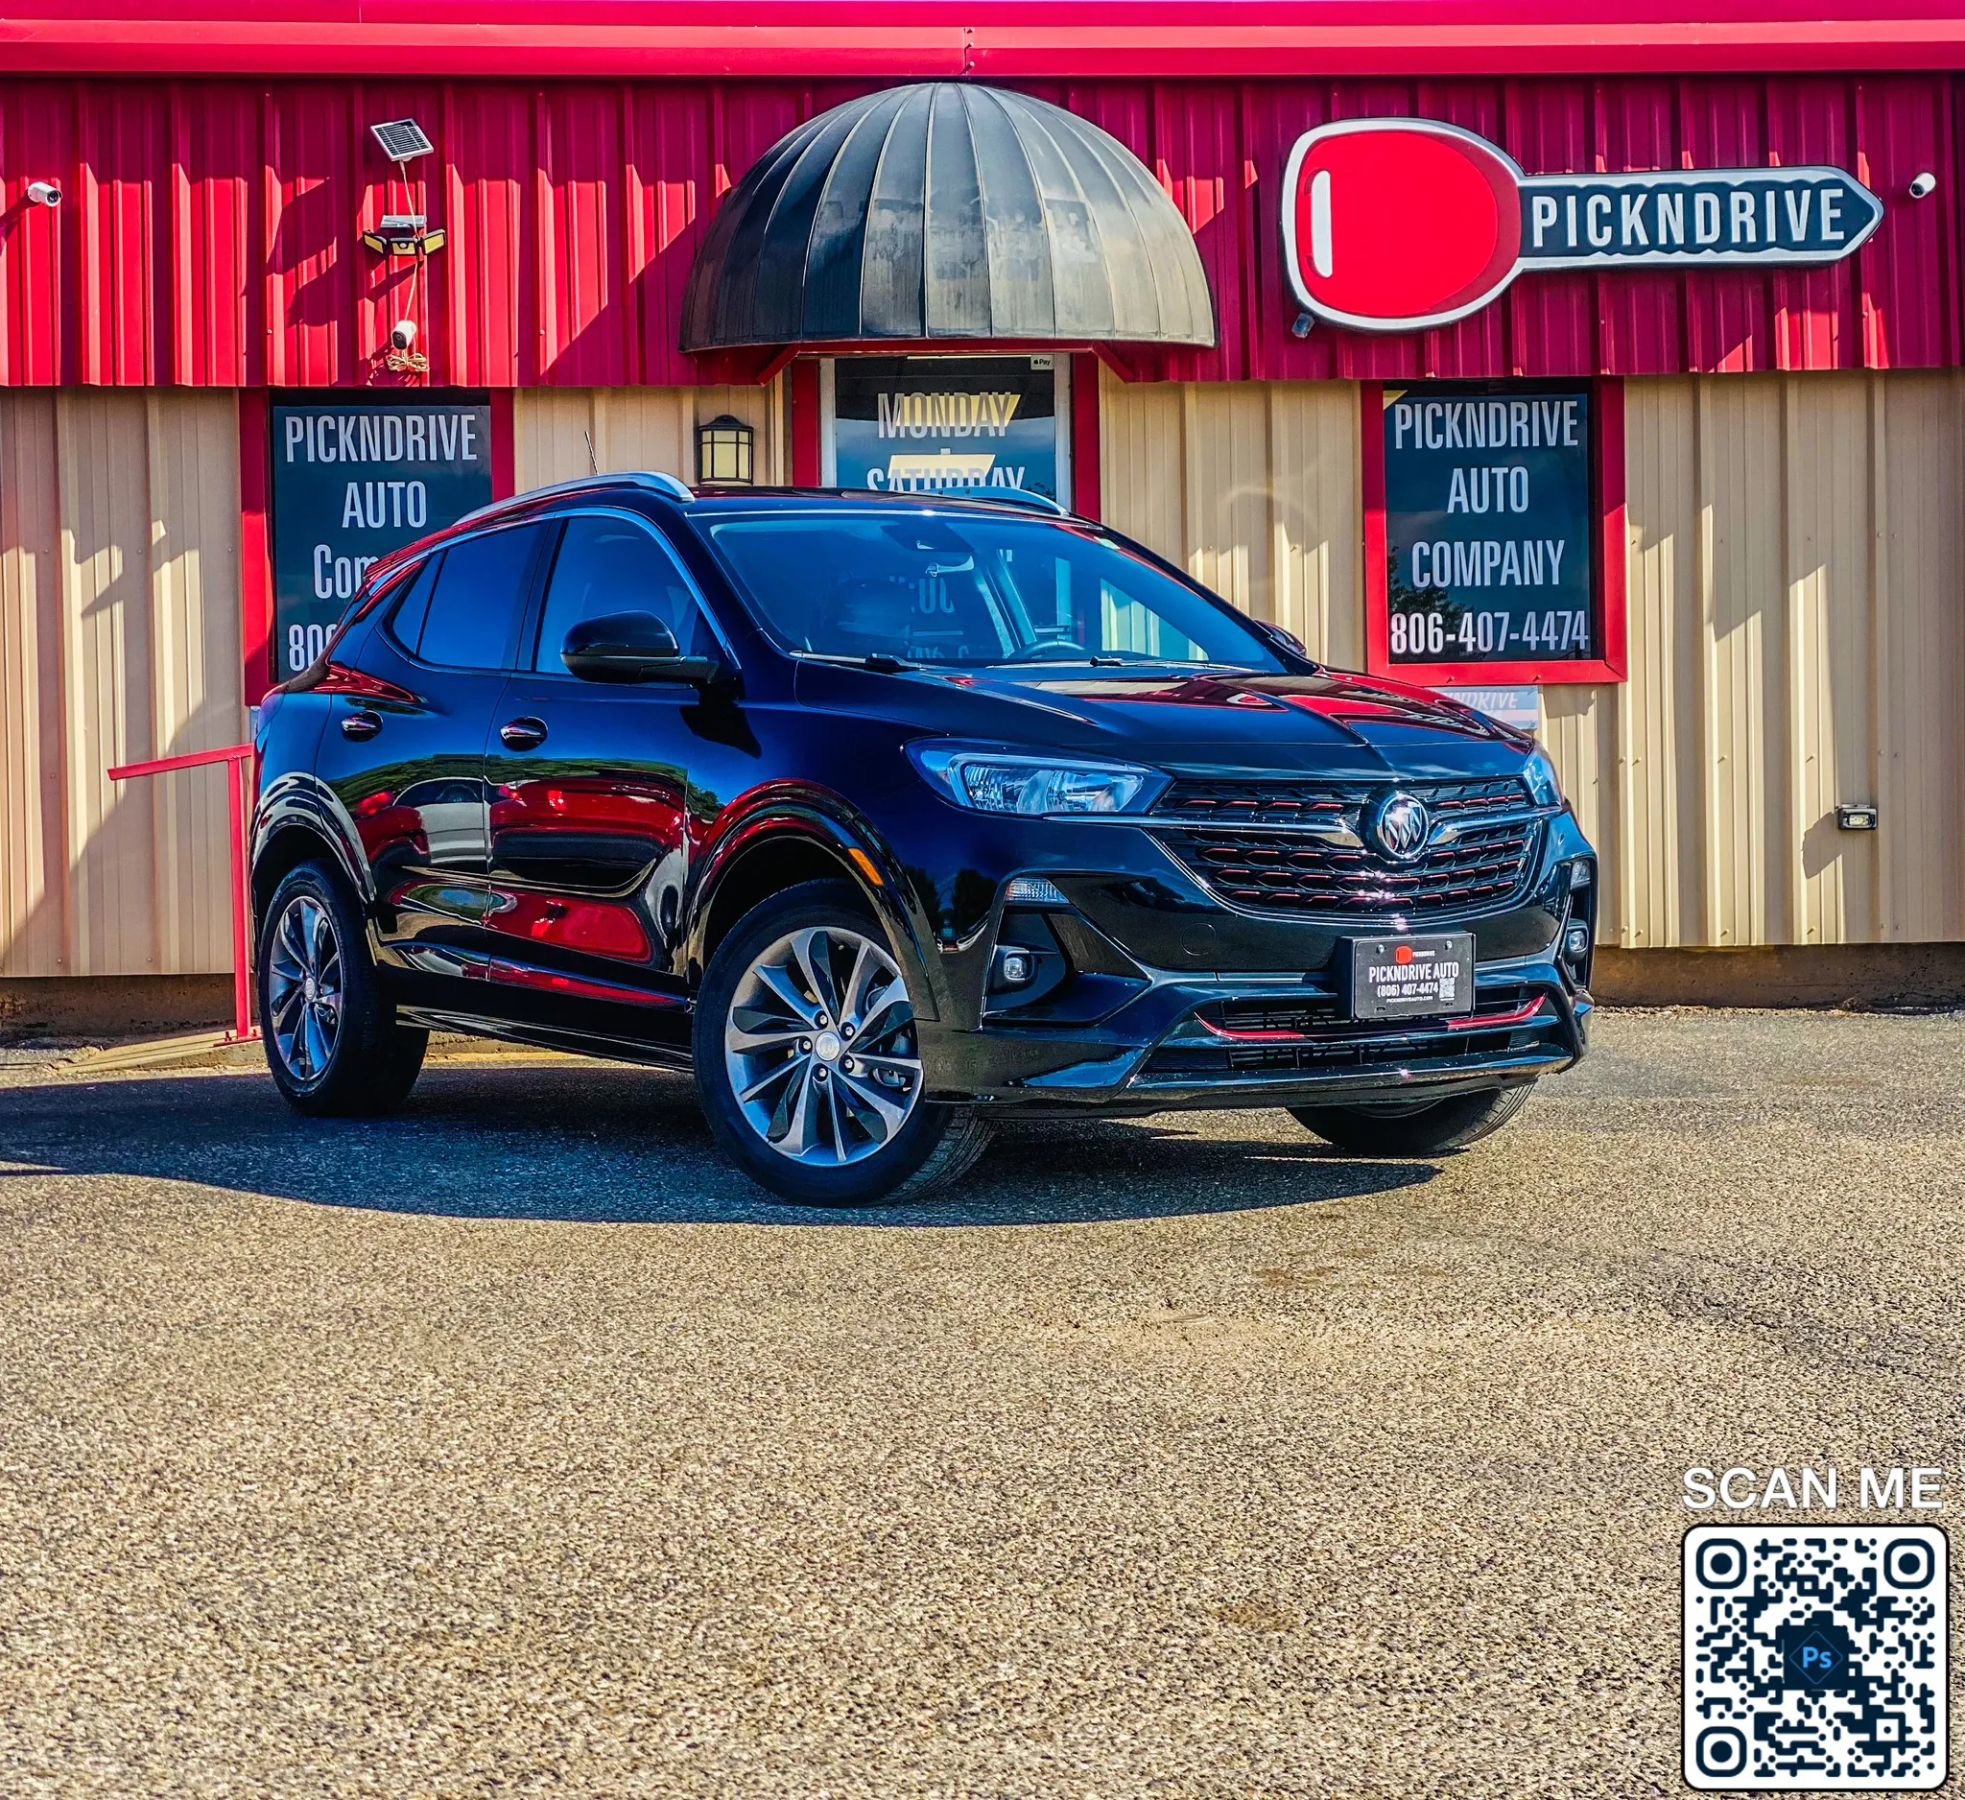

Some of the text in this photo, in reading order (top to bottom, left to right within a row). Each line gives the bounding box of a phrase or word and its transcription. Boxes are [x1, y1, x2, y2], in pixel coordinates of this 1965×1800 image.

[1532, 188, 1845, 248] PICKNDRIVE
[285, 414, 478, 463] PICKNDRIVE
[877, 392, 1011, 439] MONDAY
[1394, 400, 1579, 449] PICKNDRIVE
[341, 480, 427, 529] AUTO
[1447, 465, 1530, 514] AUTO
[1411, 540, 1565, 588] COMPANY
[1390, 610, 1589, 654] 806-407-4474
[1369, 962, 1458, 982] PICKNDRIVE AUTO
[1378, 982, 1438, 997] (806) 407-4474
